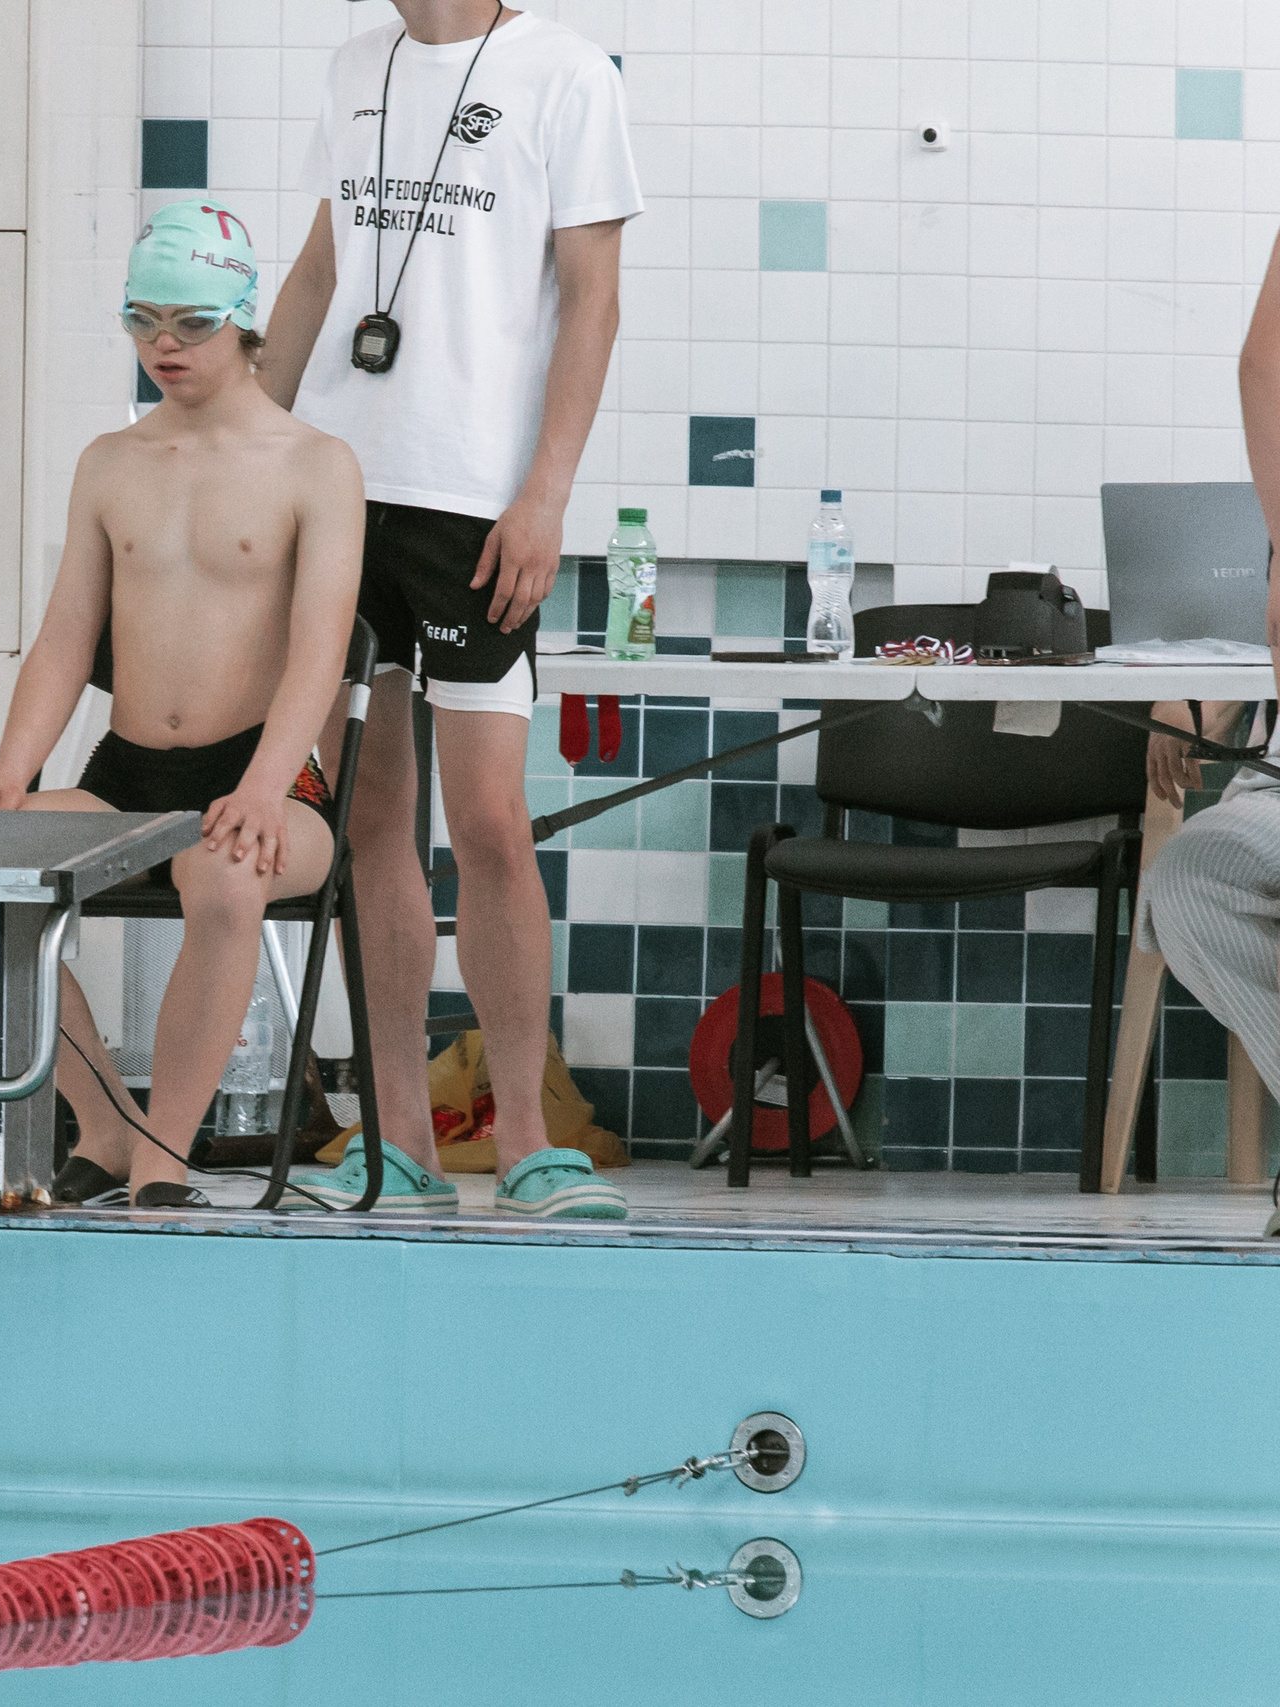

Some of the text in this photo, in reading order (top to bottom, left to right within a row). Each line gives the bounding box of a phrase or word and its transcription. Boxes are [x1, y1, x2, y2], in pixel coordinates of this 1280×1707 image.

[466, 115, 492, 133] SFB
[354, 206, 456, 236] BASKETBALL
[427, 625, 459, 642] GEAR
